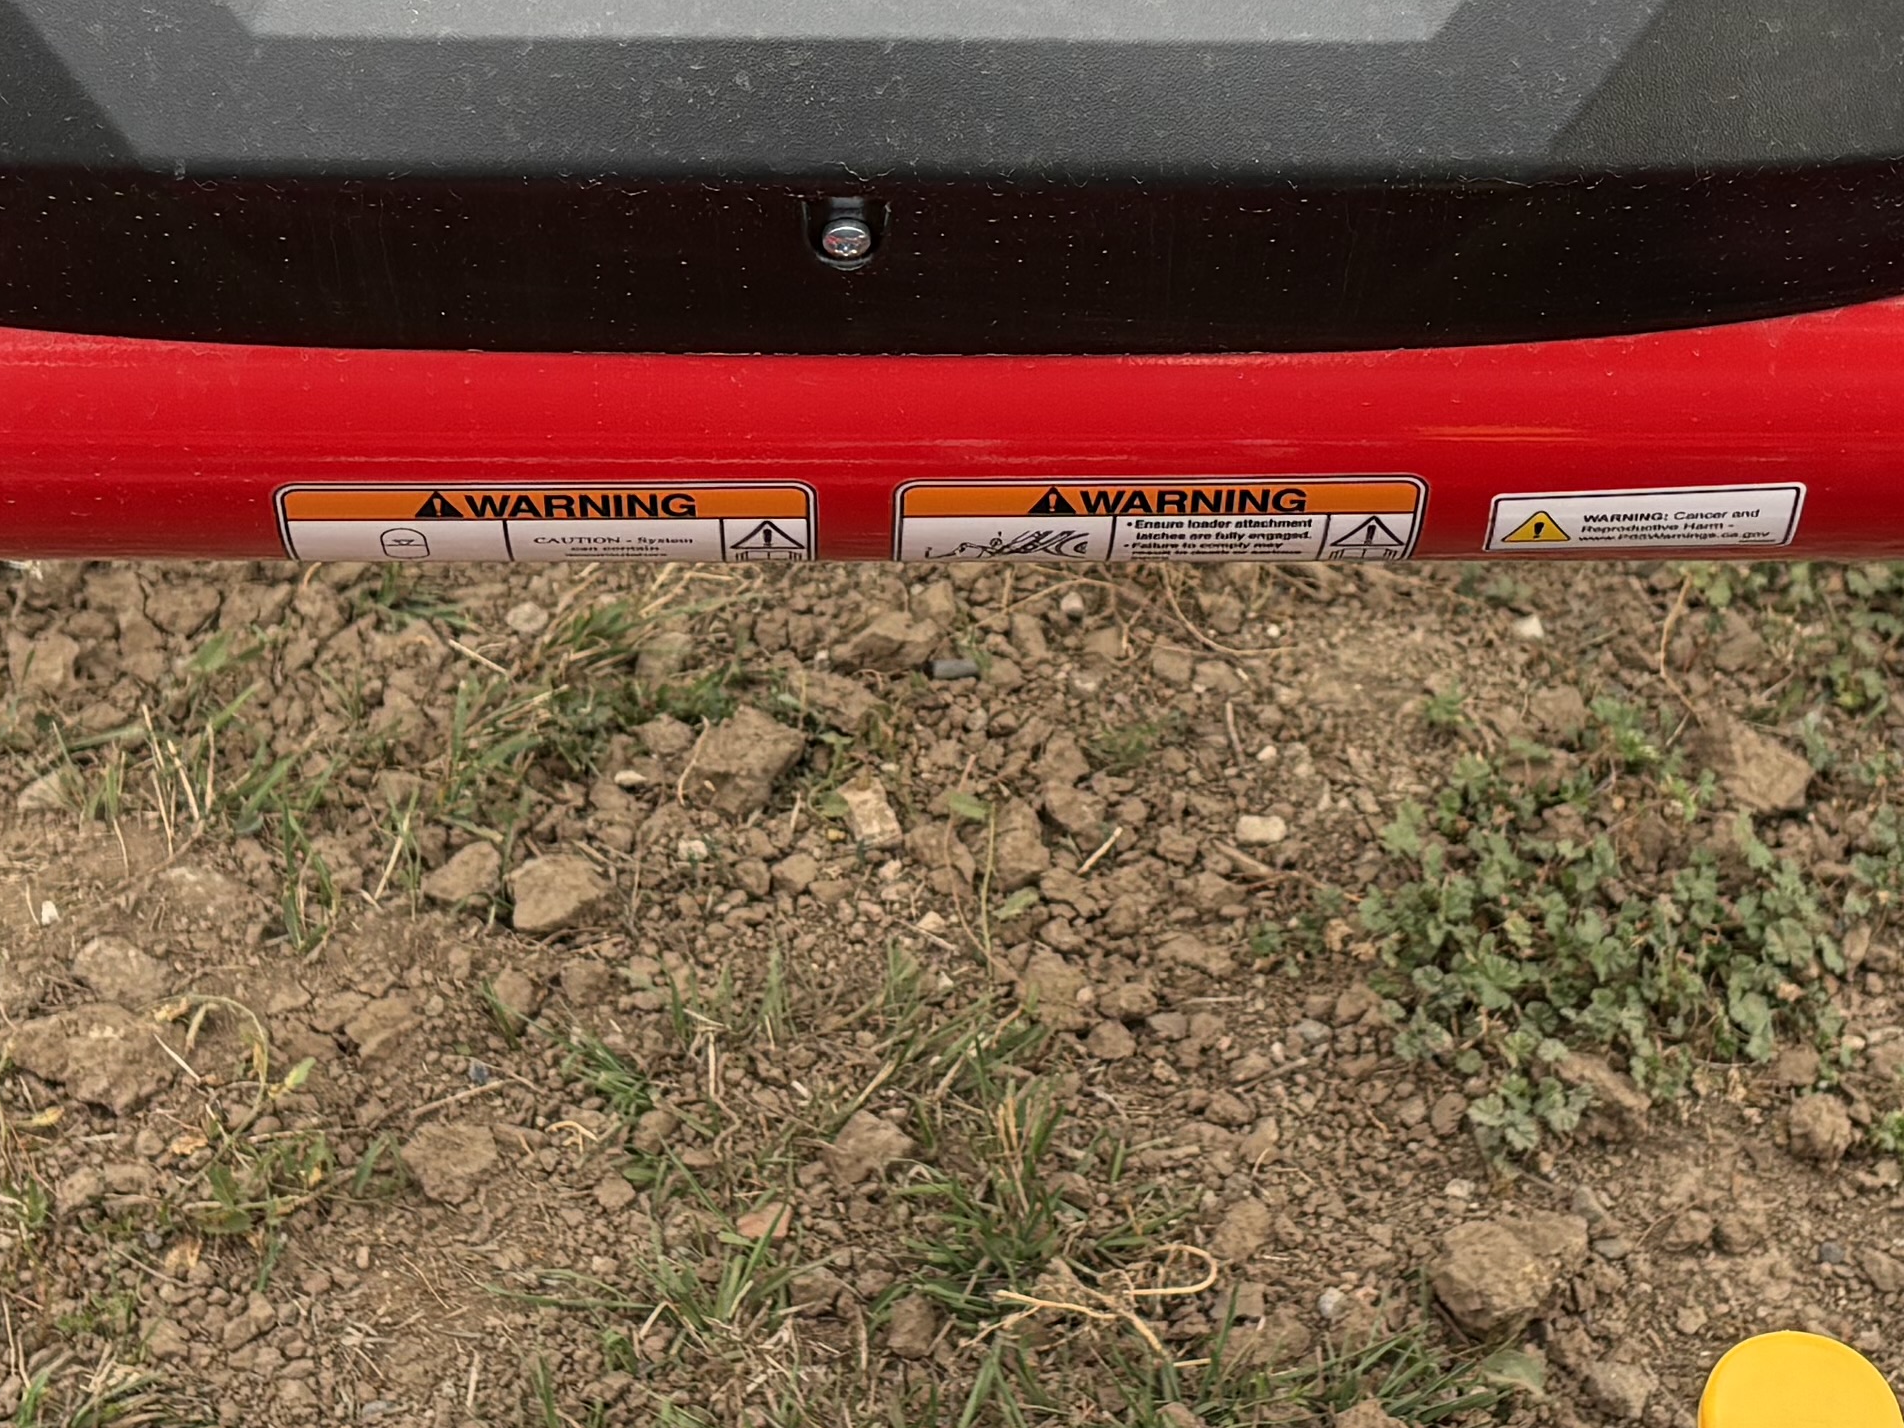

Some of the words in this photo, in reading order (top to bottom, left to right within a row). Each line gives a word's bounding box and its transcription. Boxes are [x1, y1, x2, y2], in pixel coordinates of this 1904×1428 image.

[463, 492, 697, 519] WARNING
[1080, 488, 1308, 515] WARNING
[1583, 512, 1669, 523] WARNING:
[1674, 510, 1728, 521] Cancer
[1731, 509, 1761, 519] and
[1134, 519, 1184, 529] Ensure
[1187, 518, 1231, 529] loader
[1234, 518, 1313, 529] attachment
[533, 537, 621, 545] CAUTION
